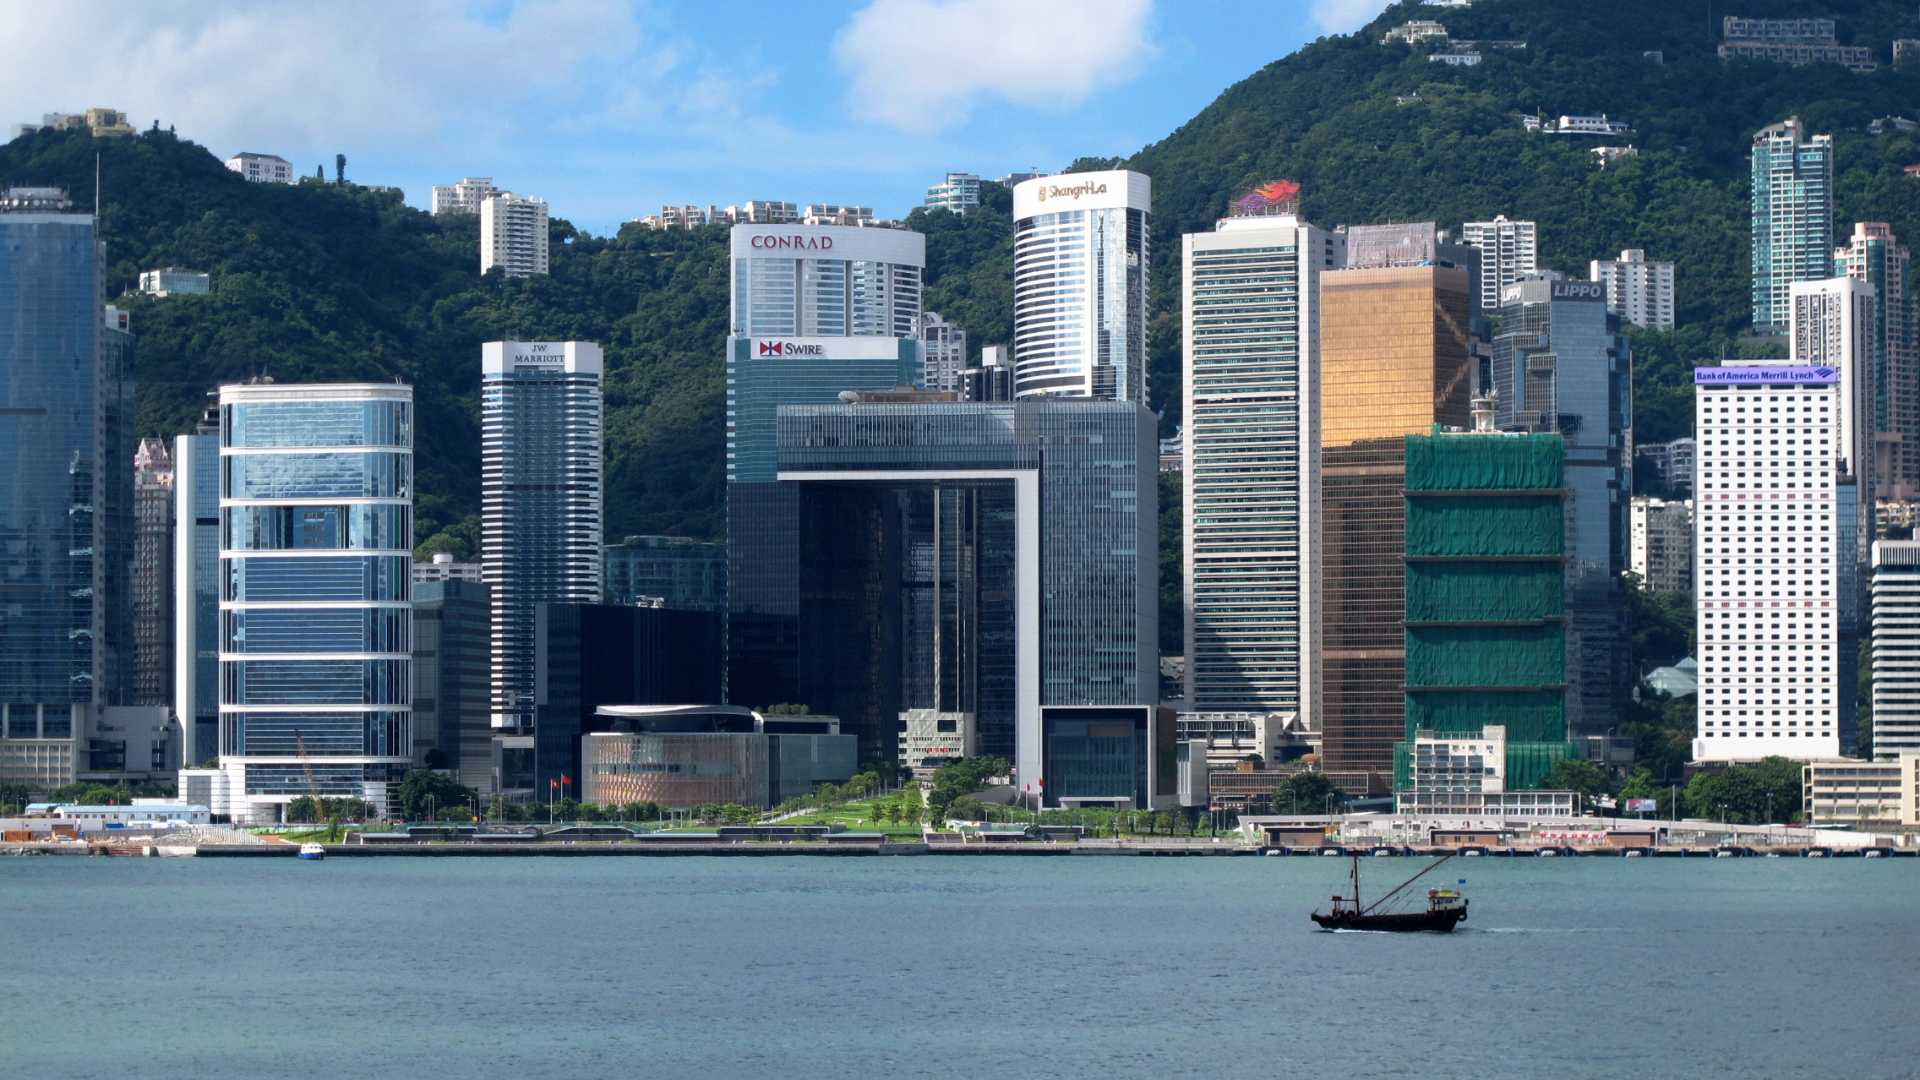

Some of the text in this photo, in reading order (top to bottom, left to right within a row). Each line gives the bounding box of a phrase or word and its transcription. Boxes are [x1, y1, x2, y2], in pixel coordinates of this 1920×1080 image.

[1049, 181, 1107, 200] Shangri-La
[751, 235, 833, 249] CONRAD
[1554, 284, 1602, 298] LIPPO
[532, 344, 548, 353] JW
[514, 354, 565, 363] MARRIOTT
[1696, 371, 1814, 381] Bank of America Merrill Lynch
